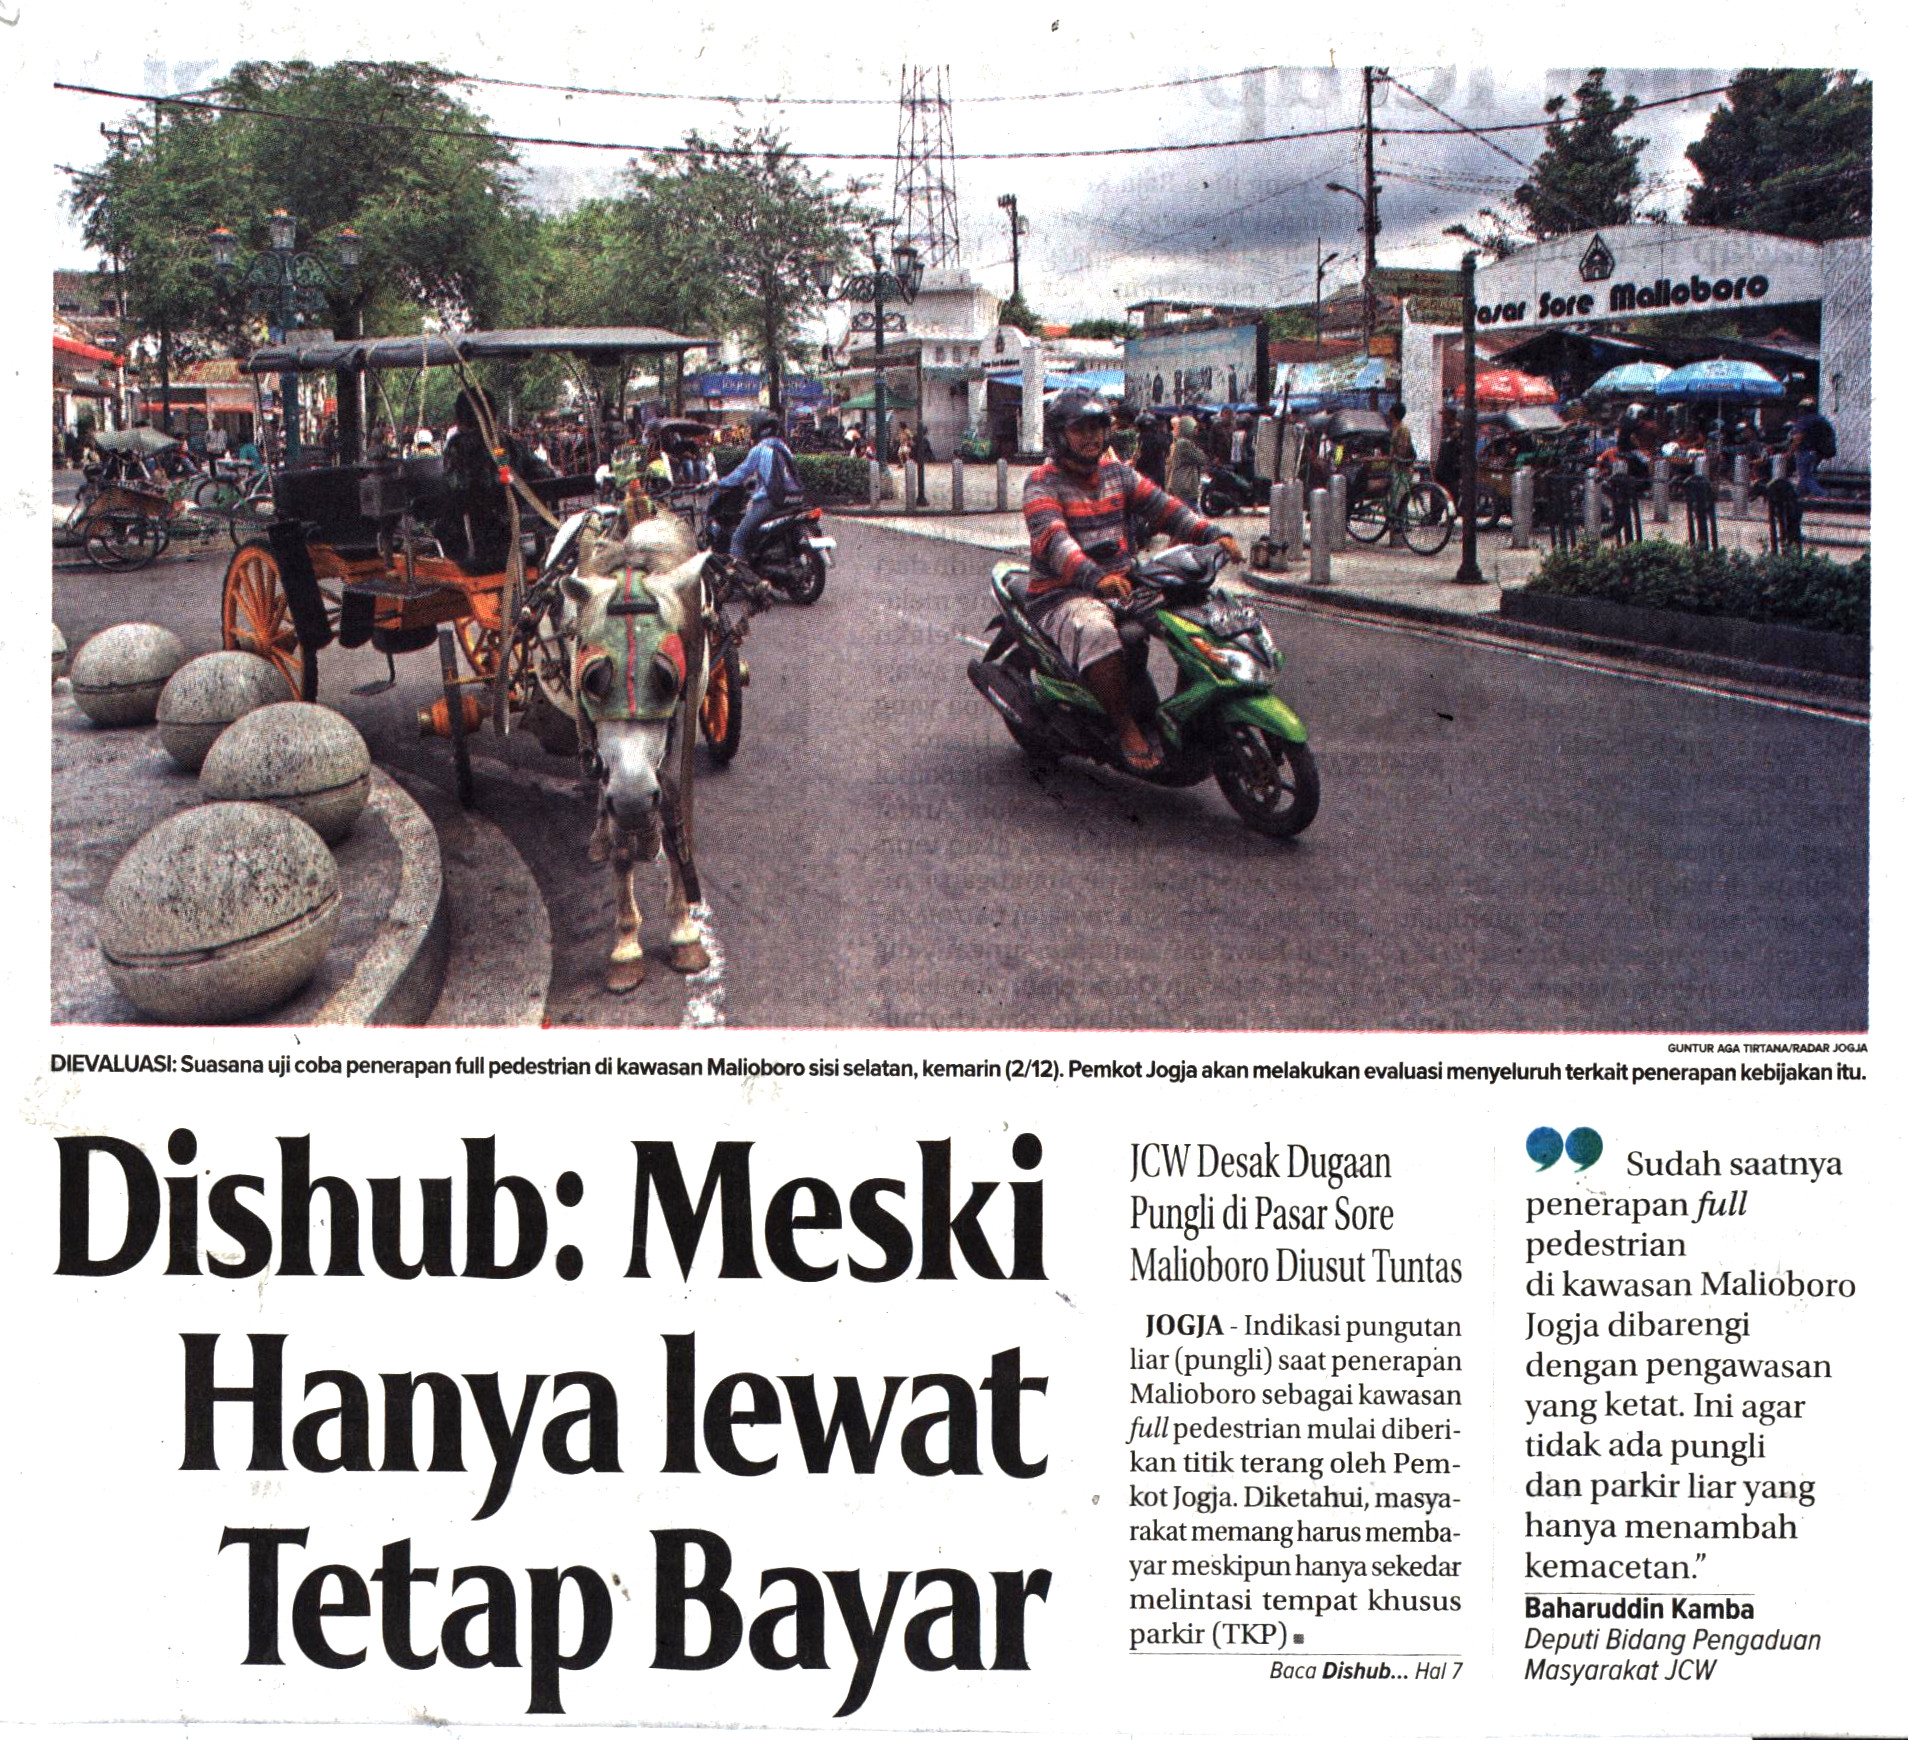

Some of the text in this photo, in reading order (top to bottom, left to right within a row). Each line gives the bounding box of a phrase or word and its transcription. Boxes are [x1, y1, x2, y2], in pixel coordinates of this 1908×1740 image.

[1474, 300, 1527, 324] asar
[1539, 291, 1595, 318] Sore
[1667, 1043, 1715, 1053] GUNTUR
[1717, 1043, 1741, 1054] AGA
[1832, 1043, 1868, 1053] JOGJA
[50, 1054, 1867, 1086] DIEVALUASI: Suasana uji coba penerapan full pedestrian di kawasan Malioboro sisi selatan, kemarin (2/12). Pemkot Jogja akan melakukan evaluasi menyeluruh terkait penerapan kebijakan itu.
[1130, 1141, 1392, 1190] JCW Desak Dugaan
[1627, 1150, 1843, 1184] Sudah saatnya
[53, 1127, 1050, 1284] Dishub: Meski
[1130, 1193, 1394, 1241] Pungli di Pasar Sore
[1526, 1190, 1748, 1225] penerapan full
[1525, 1229, 1686, 1264] pedestrian
[1130, 1245, 1462, 1284] Malioboro Diusut Tuntas
[1526, 1269, 1856, 1298] di kawasan Malioboro
[1146, 1313, 1224, 1339] JOGJA
[1244, 1313, 1341, 1337] Indikasi
[1346, 1318, 1462, 1343] pungutan
[1525, 1310, 1750, 1346] Jogja dibarengi
[1130, 1346, 1462, 1378] liar (pungli) saat penerapan
[1525, 1351, 1832, 1385] dengan pengawasan
[1130, 1381, 1462, 1412] Malioboro sebagai kawasan
[1525, 1390, 1806, 1426] yang ketat. Ini agar
[178, 1331, 1049, 1521] Hanya lewat
[1125, 1415, 1461, 1445] full pedestrian mulai diberi-
[1525, 1430, 1765, 1467] tidak ada pungli
[1130, 1450, 1461, 1480] kan titik terang oleh Pem-
[1129, 1484, 1461, 1515] kot Jogja. Diketahui, masya-
[1525, 1470, 1816, 1508] dan parkir liar yang
[1129, 1518, 1461, 1549] rakat memang harus memba-
[1525, 1511, 1798, 1546] hanya menambah
[1129, 1553, 1462, 1583] yar meskipun hanya sekedar
[1130, 1587, 1462, 1617] melintasi tempat khusus
[1525, 1592, 1754, 1620] Baharuddin Kamba
[218, 1525, 1053, 1718] Tetap Bayar
[1129, 1620, 1287, 1651] parkir (TKP)
[1524, 1627, 1821, 1656] Deputi Bidang Pengaduan
[1269, 1660, 1464, 1680] Baca Dishub... Hal 7
[1524, 1658, 1718, 1687] Masyarakat JCW
